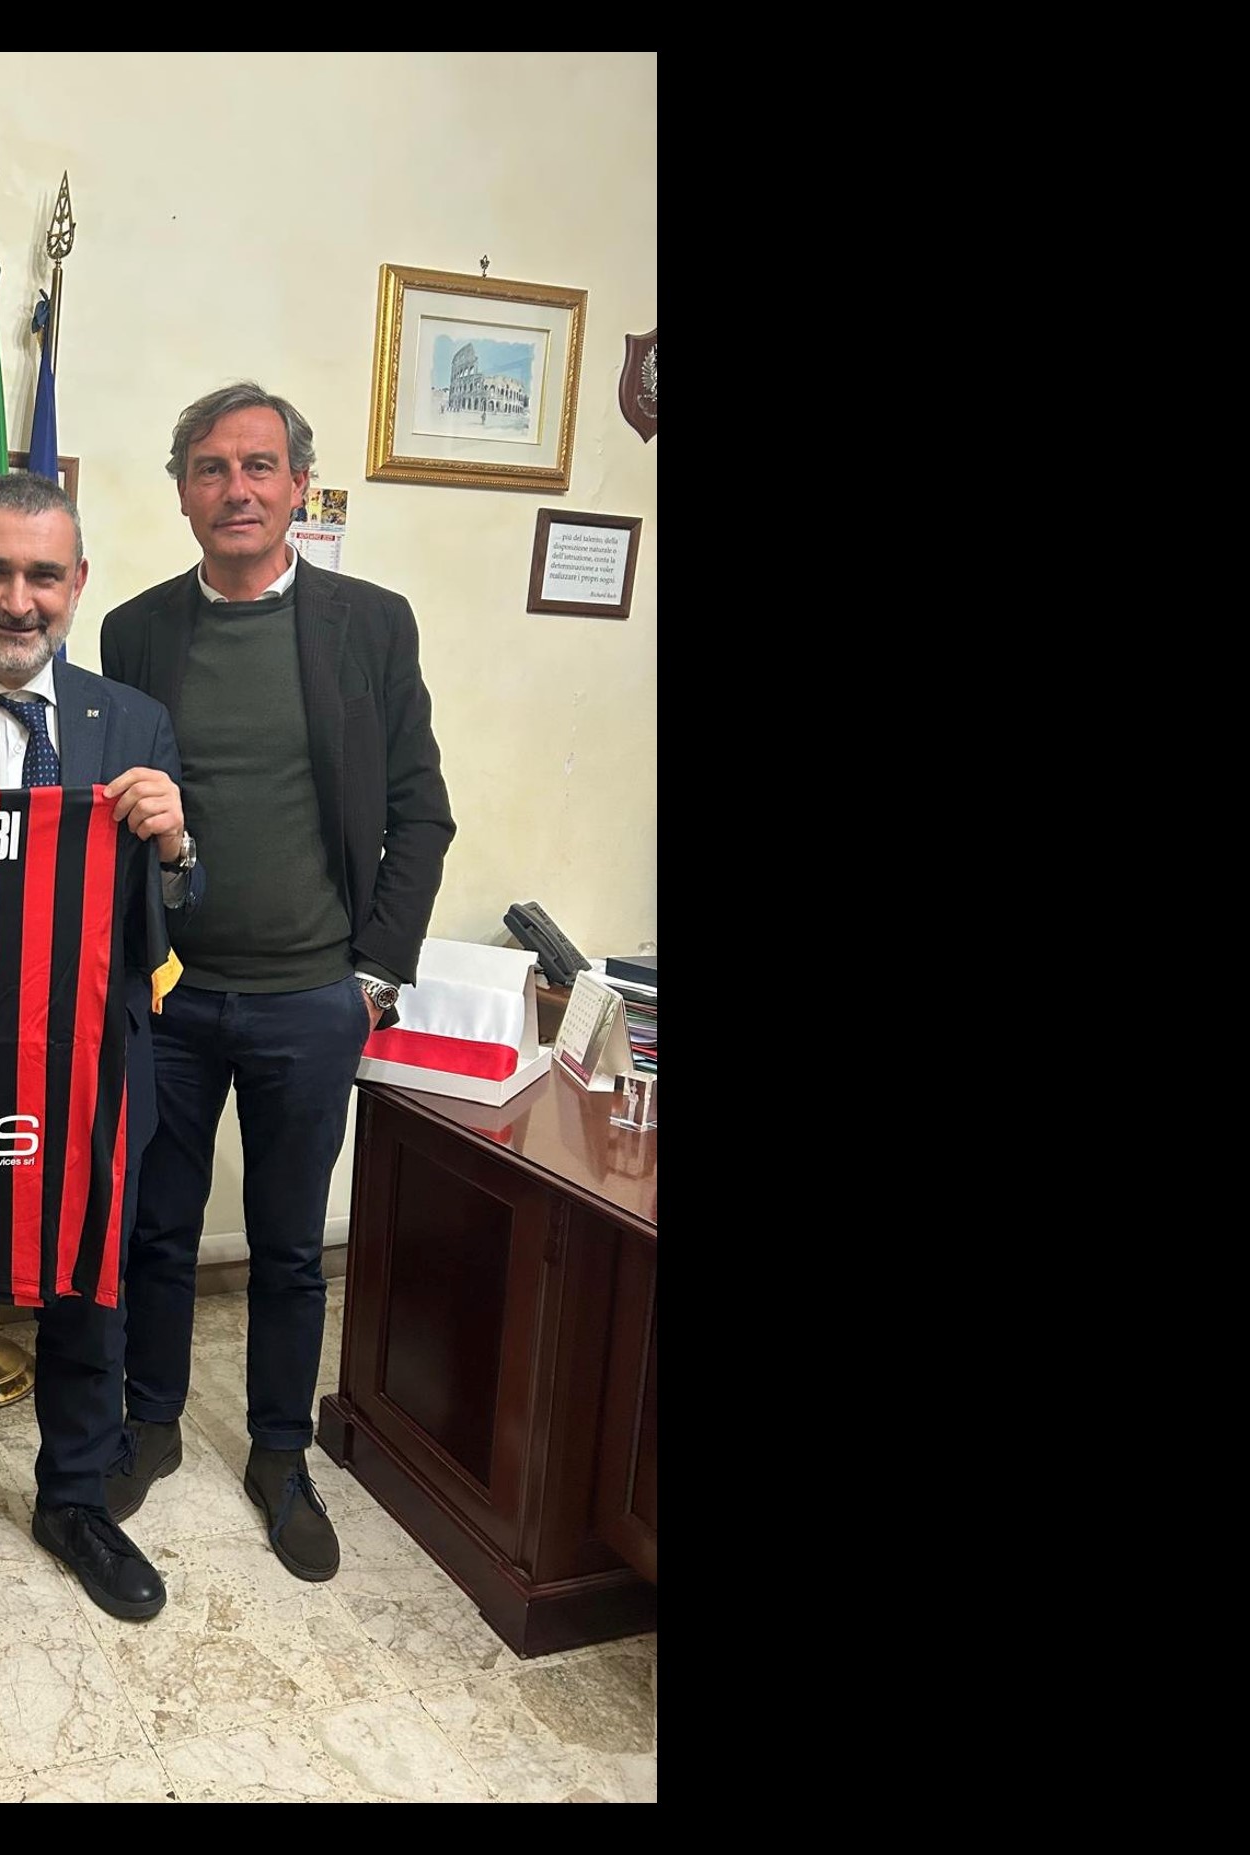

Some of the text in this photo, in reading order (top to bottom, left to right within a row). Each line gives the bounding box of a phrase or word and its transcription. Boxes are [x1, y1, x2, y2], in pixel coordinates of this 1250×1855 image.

[573, 533, 582, 541] del
[553, 542, 589, 551] disposizione
[589, 545, 612, 553] naturale
[550, 562, 594, 572] determinazione
[580, 575, 599, 584] propri
[23, 1157, 35, 1166] srl
